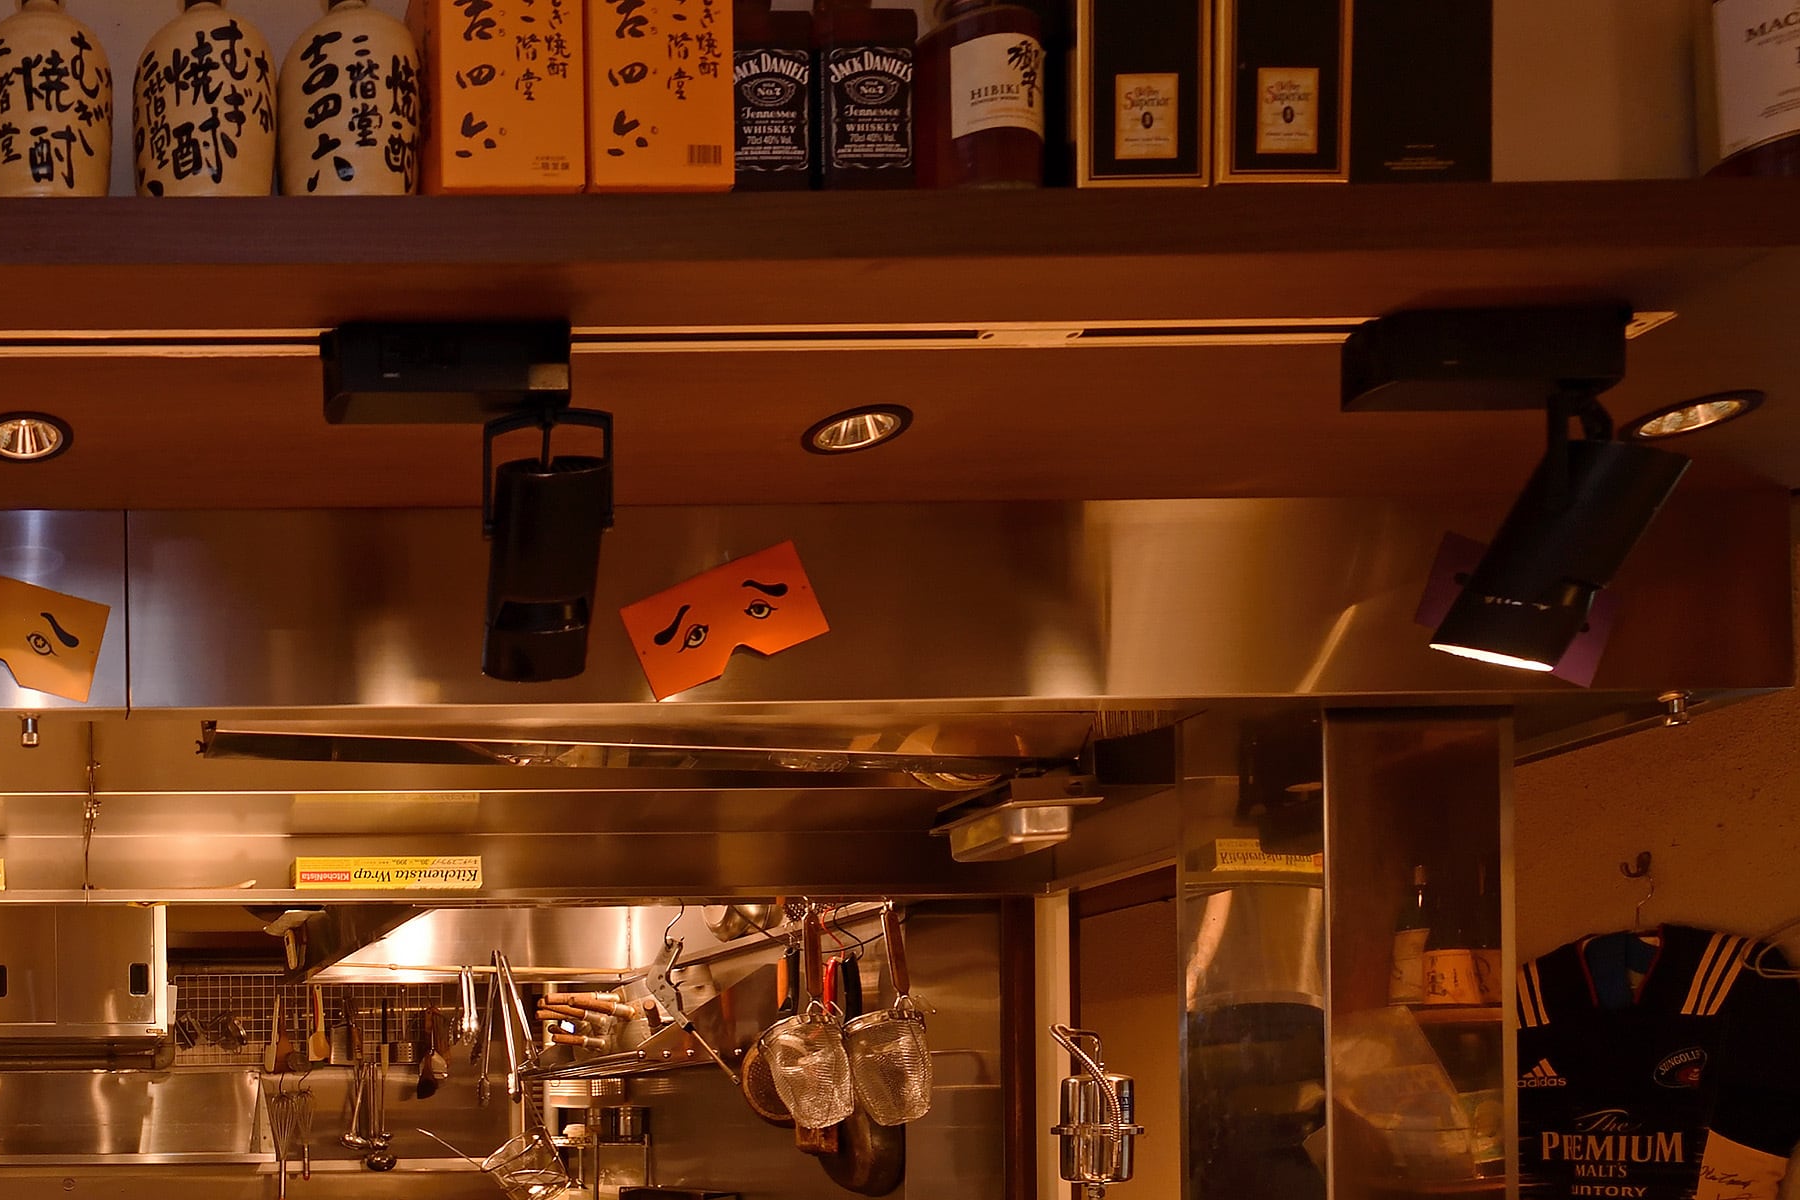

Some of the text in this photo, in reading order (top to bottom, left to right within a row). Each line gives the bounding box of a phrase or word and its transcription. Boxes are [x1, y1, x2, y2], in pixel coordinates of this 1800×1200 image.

[829, 50, 913, 84] JACK DANIEL'S
[970, 84, 1020, 101] HIBIKI
[742, 125, 797, 134] WHISKEY
[845, 123, 900, 132] WHISKEY
[353, 867, 478, 882] Kitchenista Wrap
[1516, 1076, 1567, 1088] adidas
